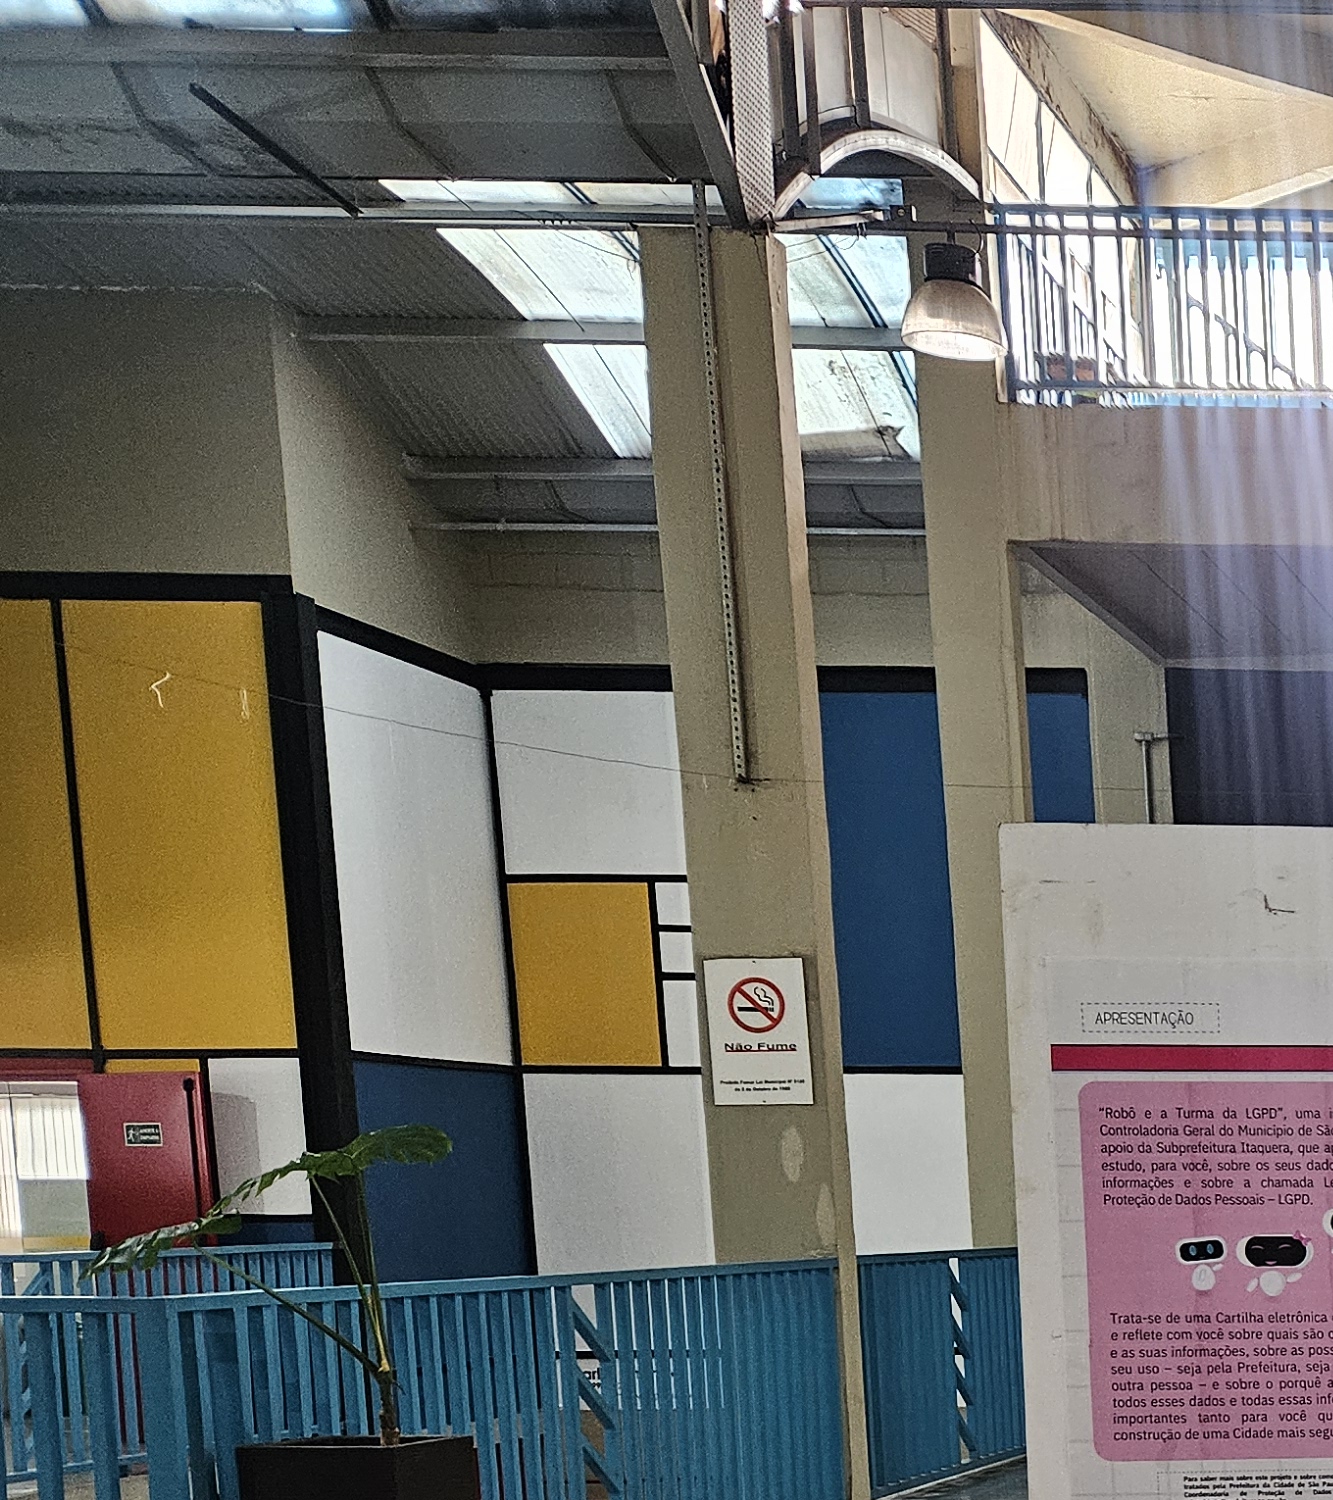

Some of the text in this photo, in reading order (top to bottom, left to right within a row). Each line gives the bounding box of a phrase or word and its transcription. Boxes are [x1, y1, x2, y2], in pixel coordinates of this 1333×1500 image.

[1094, 1009, 1194, 1029] APRESENTAÇÃO
[724, 1042, 797, 1051] Não Fume
[1143, 1109, 1152, 1120] e
[1159, 1109, 1168, 1119] a
[1174, 1106, 1214, 1119] Turma
[1221, 1106, 1237, 1119] da
[1294, 1109, 1321, 1119] uma
[1182, 1123, 1215, 1137] Geral
[1218, 1123, 1234, 1137] do
[1297, 1123, 1313, 1136] de
[1100, 1140, 1134, 1157] apoio
[1137, 1140, 1153, 1154] da
[1155, 1140, 1237, 1157] Subprefeitura
[1240, 1141, 1294, 1156] Itaquera,
[1297, 1143, 1320, 1157] que
[1100, 1158, 1146, 1173] estudo,
[1150, 1161, 1177, 1174] para
[1181, 1158, 1212, 1173] você,
[1216, 1159, 1250, 1171] sobre
[1255, 1161, 1270, 1171] os
[1274, 1161, 1301, 1171] seus
[1101, 1175, 1174, 1191] informações
[1183, 1178, 1192, 1189] e
[1200, 1175, 1234, 1189] sobre
[1243, 1178, 1251, 1188] a
[1260, 1175, 1314, 1189] chamada
[1103, 1192, 1156, 1208] Proteção
[1157, 1192, 1172, 1206] de
[1174, 1193, 1212, 1206] Dados
[1214, 1192, 1265, 1206] Pessoais
[1277, 1192, 1313, 1205] LGPD.
[1109, 1312, 1162, 1324] Trata-se
[1165, 1311, 1181, 1324] de
[1184, 1314, 1212, 1324] uma
[1215, 1311, 1264, 1324] Cartilha
[1267, 1309, 1328, 1324] eletrônica
[1110, 1331, 1118, 1341] e
[1122, 1327, 1163, 1341] reflete
[1166, 1330, 1192, 1341] com
[1195, 1327, 1224, 1342] você
[1227, 1327, 1263, 1340] sobre
[1266, 1327, 1299, 1342] quais
[1302, 1327, 1324, 1340] são
[1109, 1349, 1118, 1359] e
[1120, 1348, 1135, 1358] as
[1138, 1348, 1168, 1358] suas
[1170, 1344, 1249, 1360] informações,
[1252, 1343, 1287, 1357] sobre
[1290, 1346, 1304, 1356] as
[1110, 1365, 1132, 1375] seu
[1136, 1364, 1160, 1375] uso
[1176, 1361, 1202, 1377] seja
[1206, 1361, 1232, 1376] pela
[1237, 1360, 1301, 1374] Prefeitura,
[1305, 1359, 1330, 1375] seja
